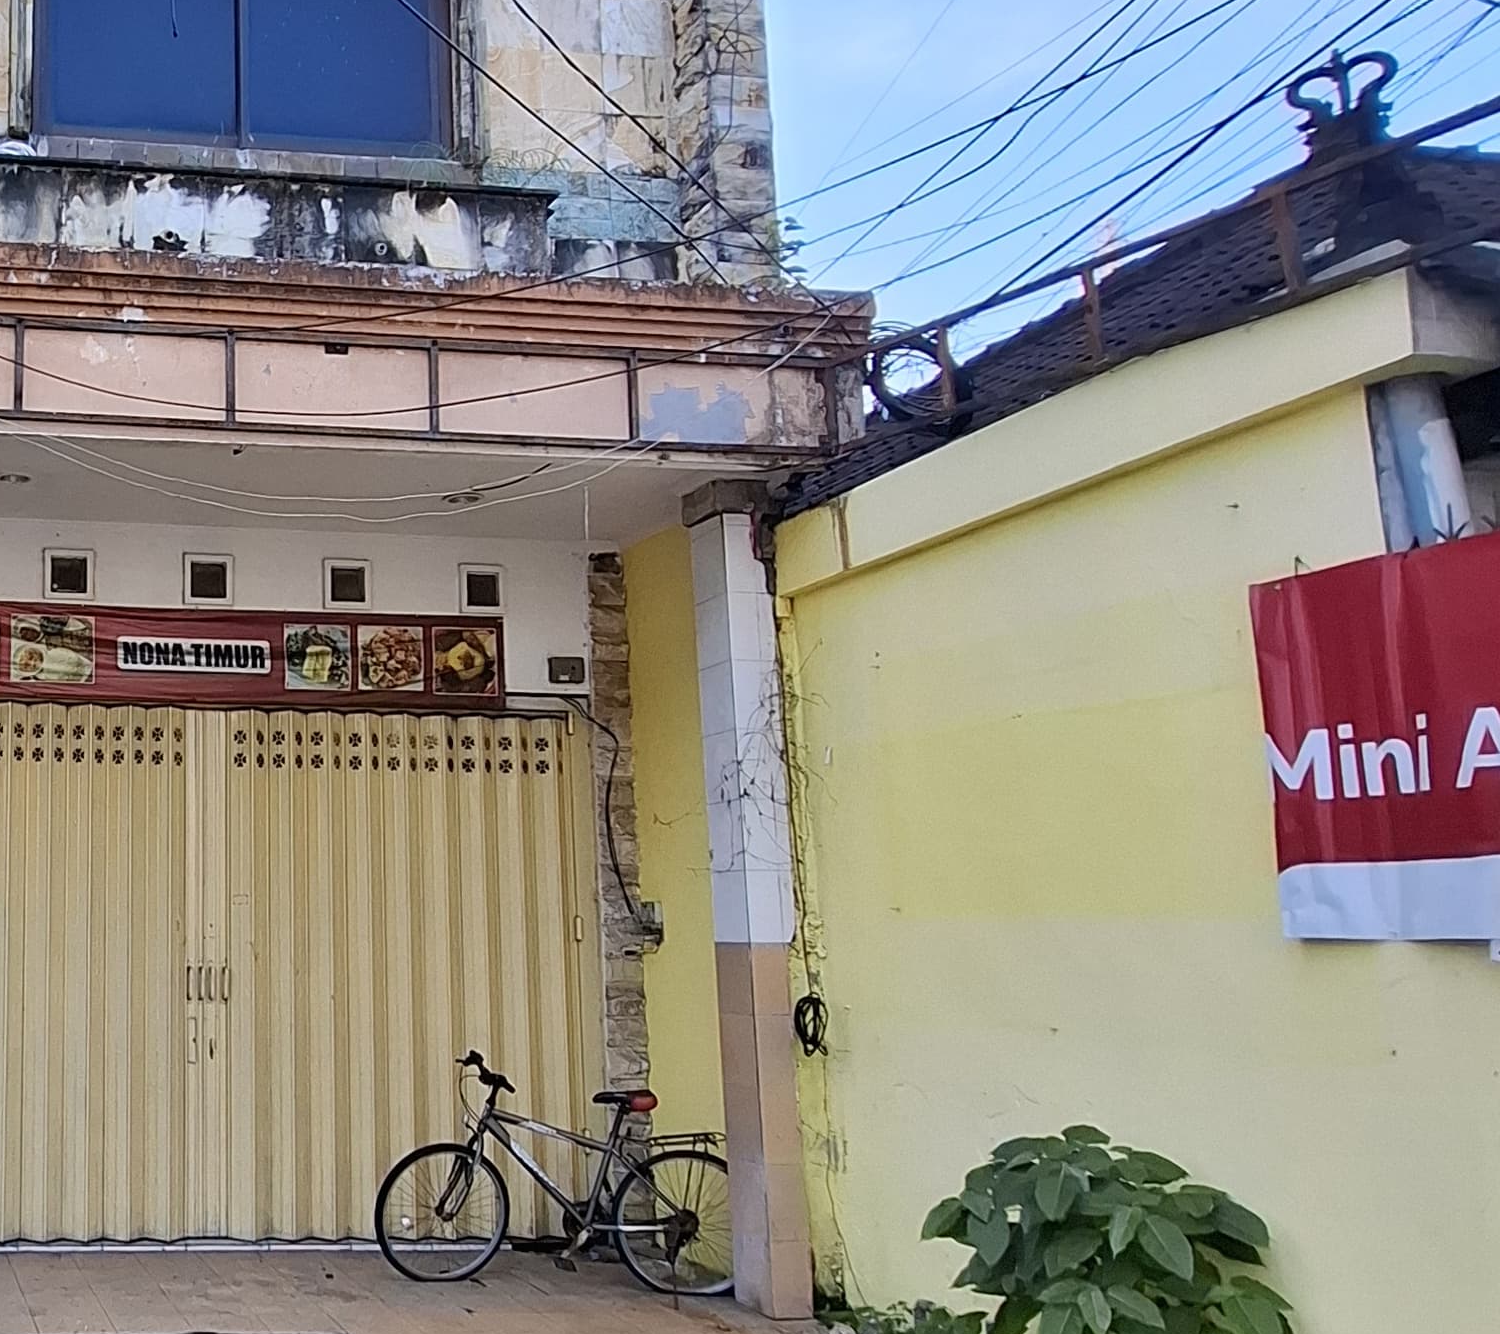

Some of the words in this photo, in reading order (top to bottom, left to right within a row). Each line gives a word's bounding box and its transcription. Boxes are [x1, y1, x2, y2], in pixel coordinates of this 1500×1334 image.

[122, 642, 187, 666] NONA
[191, 644, 266, 669] TIMUR
[1265, 713, 1431, 800] Mini
